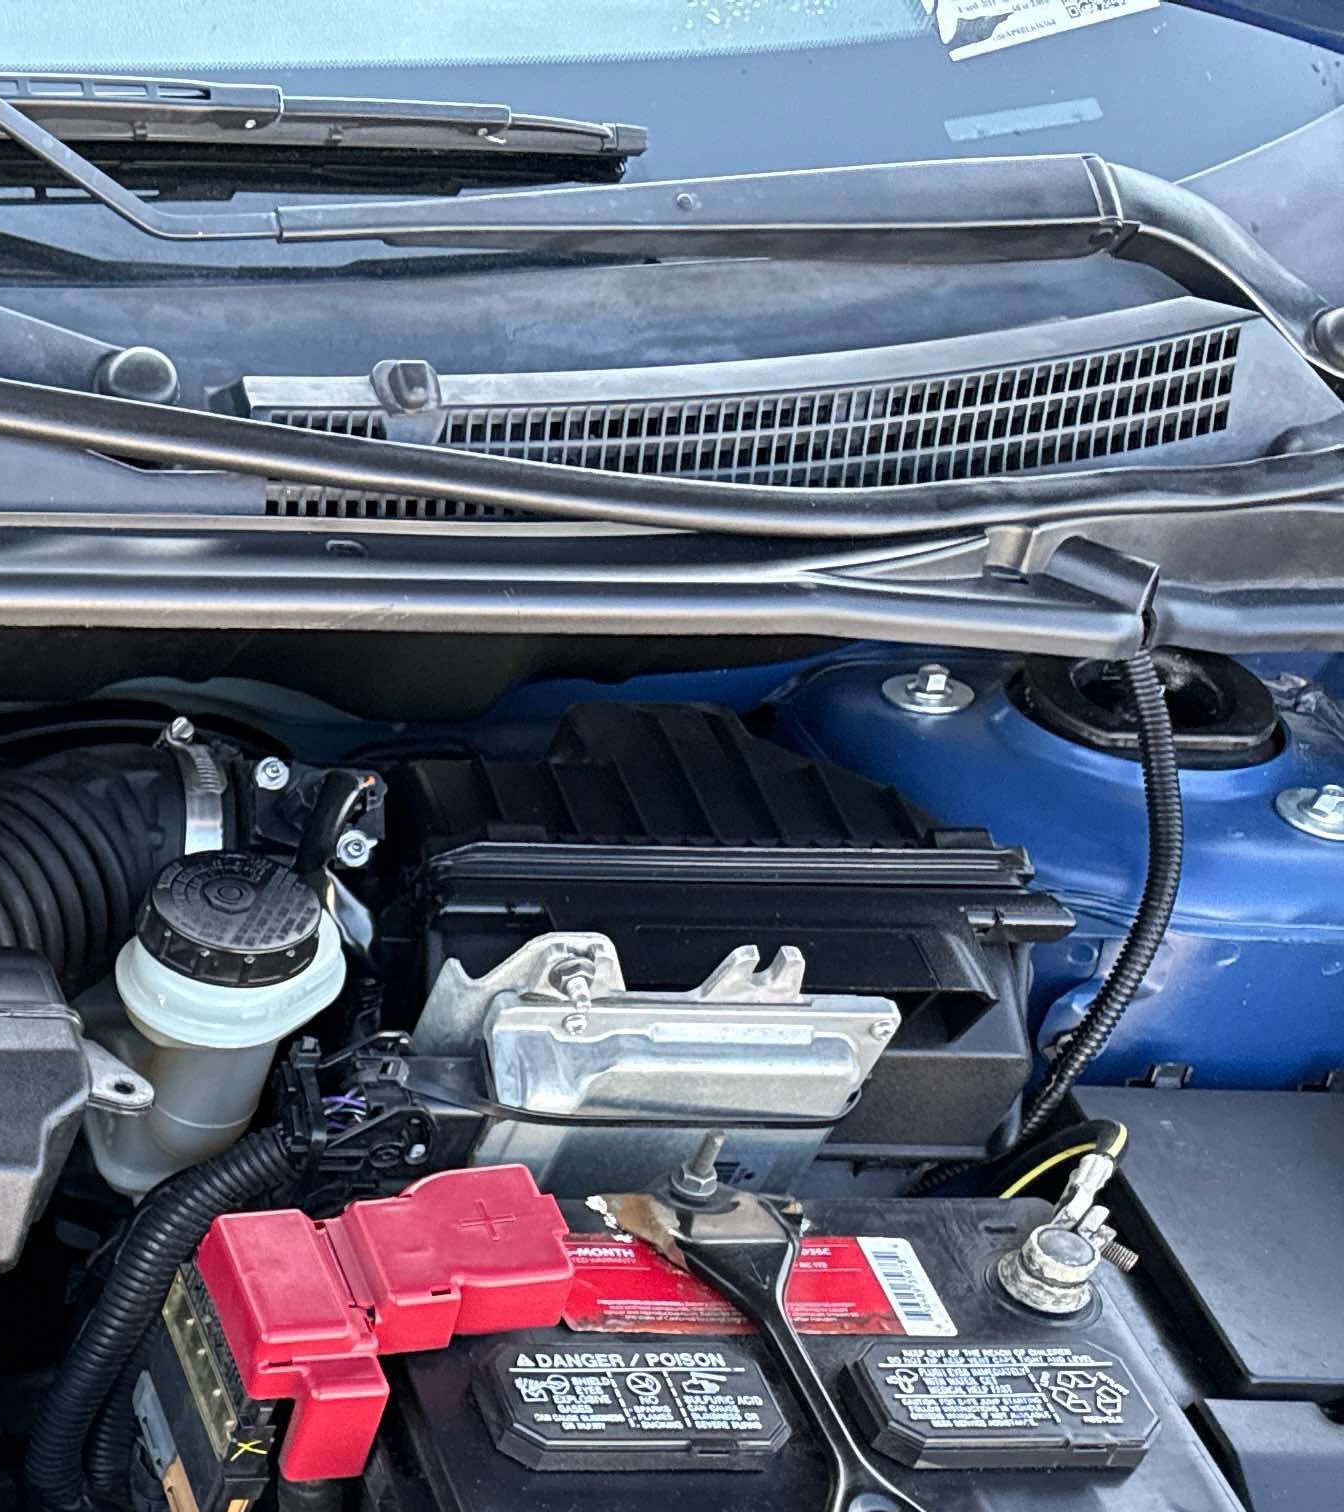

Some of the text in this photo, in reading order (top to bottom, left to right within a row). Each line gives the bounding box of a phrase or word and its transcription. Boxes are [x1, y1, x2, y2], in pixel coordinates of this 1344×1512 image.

[535, 1352, 726, 1367] DANGER / POISON
